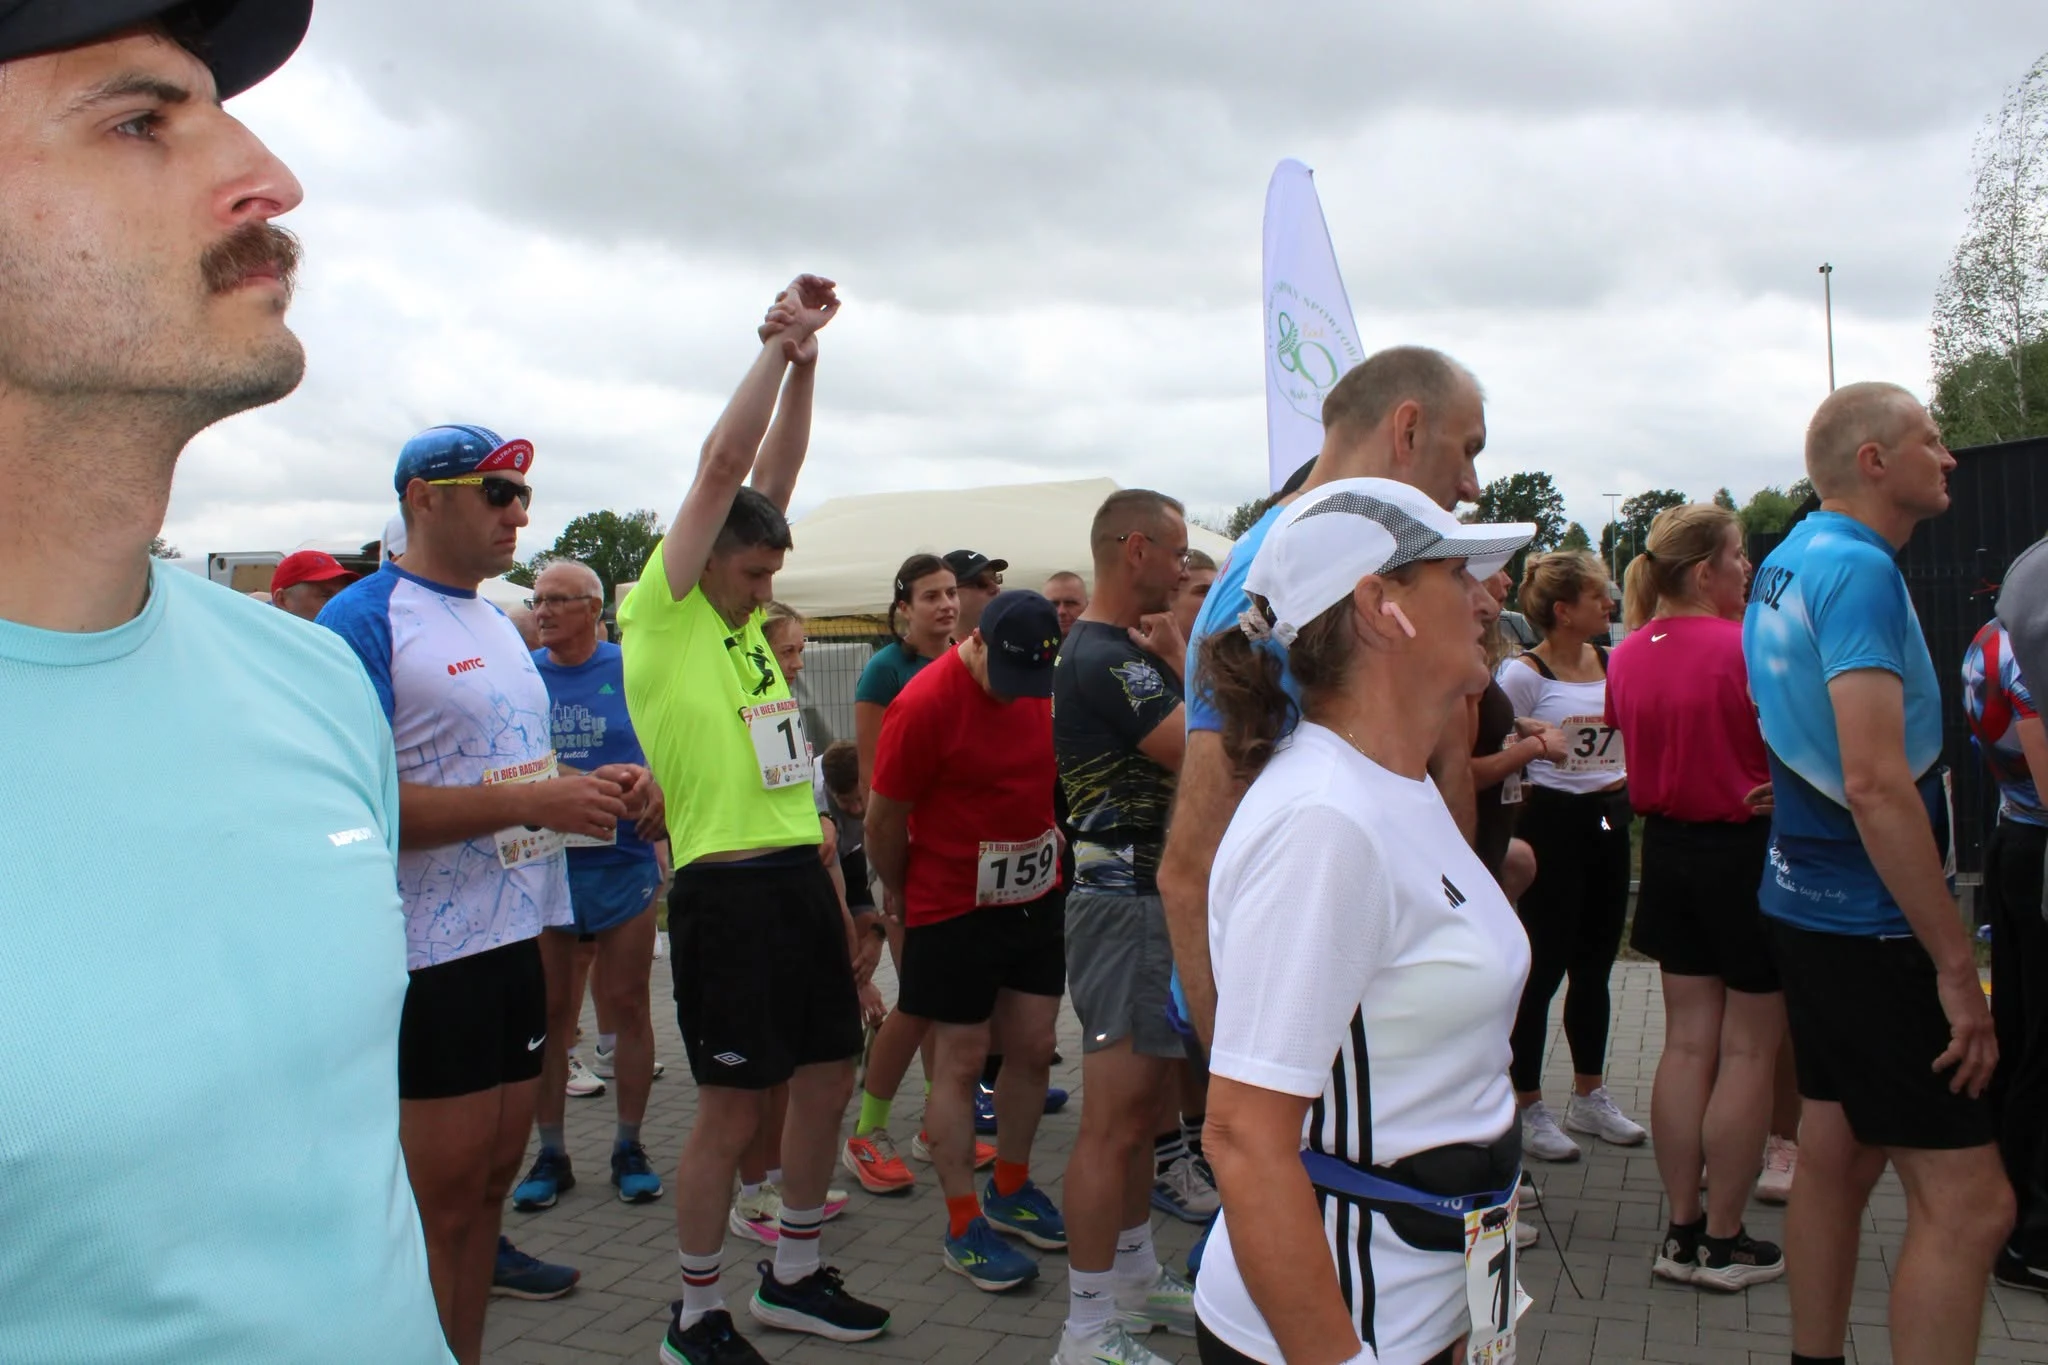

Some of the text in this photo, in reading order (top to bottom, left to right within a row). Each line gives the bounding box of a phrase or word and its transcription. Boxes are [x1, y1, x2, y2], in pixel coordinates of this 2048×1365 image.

[456, 657, 485, 672] MTC
[760, 703, 776, 715] BIEG
[1574, 727, 1617, 758] 37
[501, 766, 518, 781] BIEG
[990, 843, 1054, 890] 159
